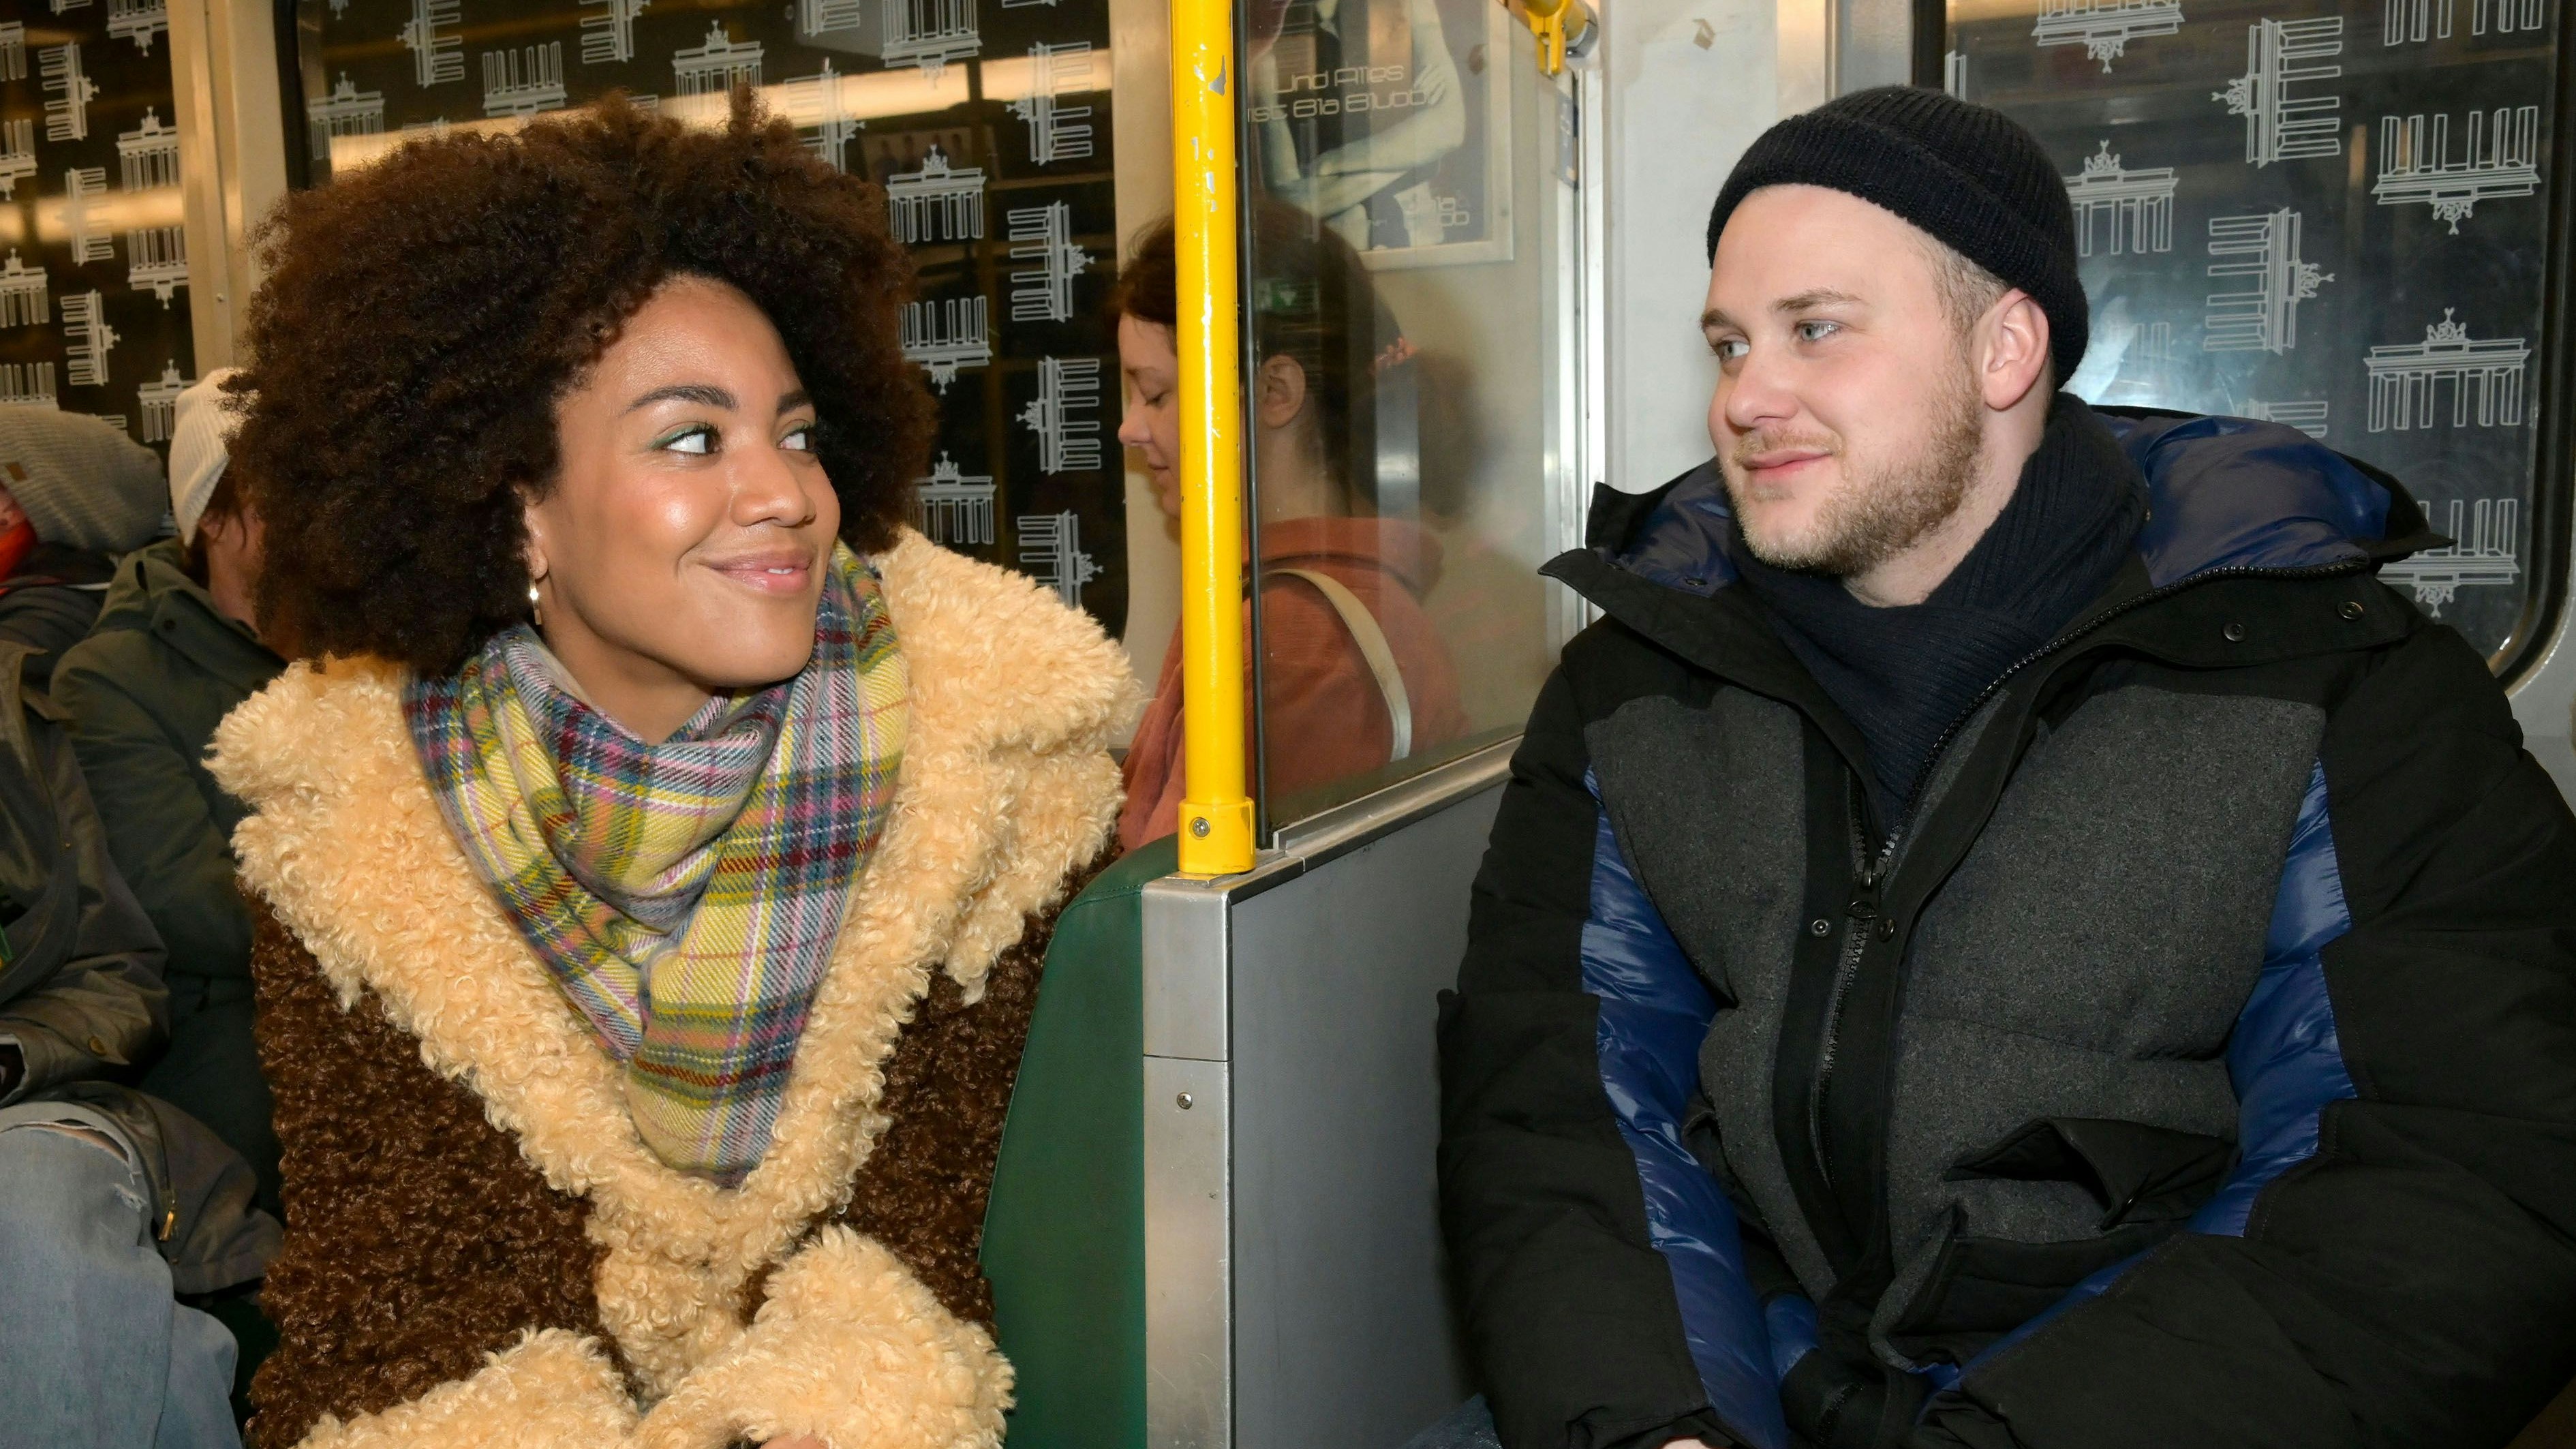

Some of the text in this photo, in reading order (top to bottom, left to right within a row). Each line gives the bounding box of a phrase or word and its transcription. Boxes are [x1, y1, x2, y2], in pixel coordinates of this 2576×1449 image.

[1335, 65, 1404, 87] Alles
[1293, 99, 1339, 119] Bla
[1346, 90, 1426, 112] Blubb
